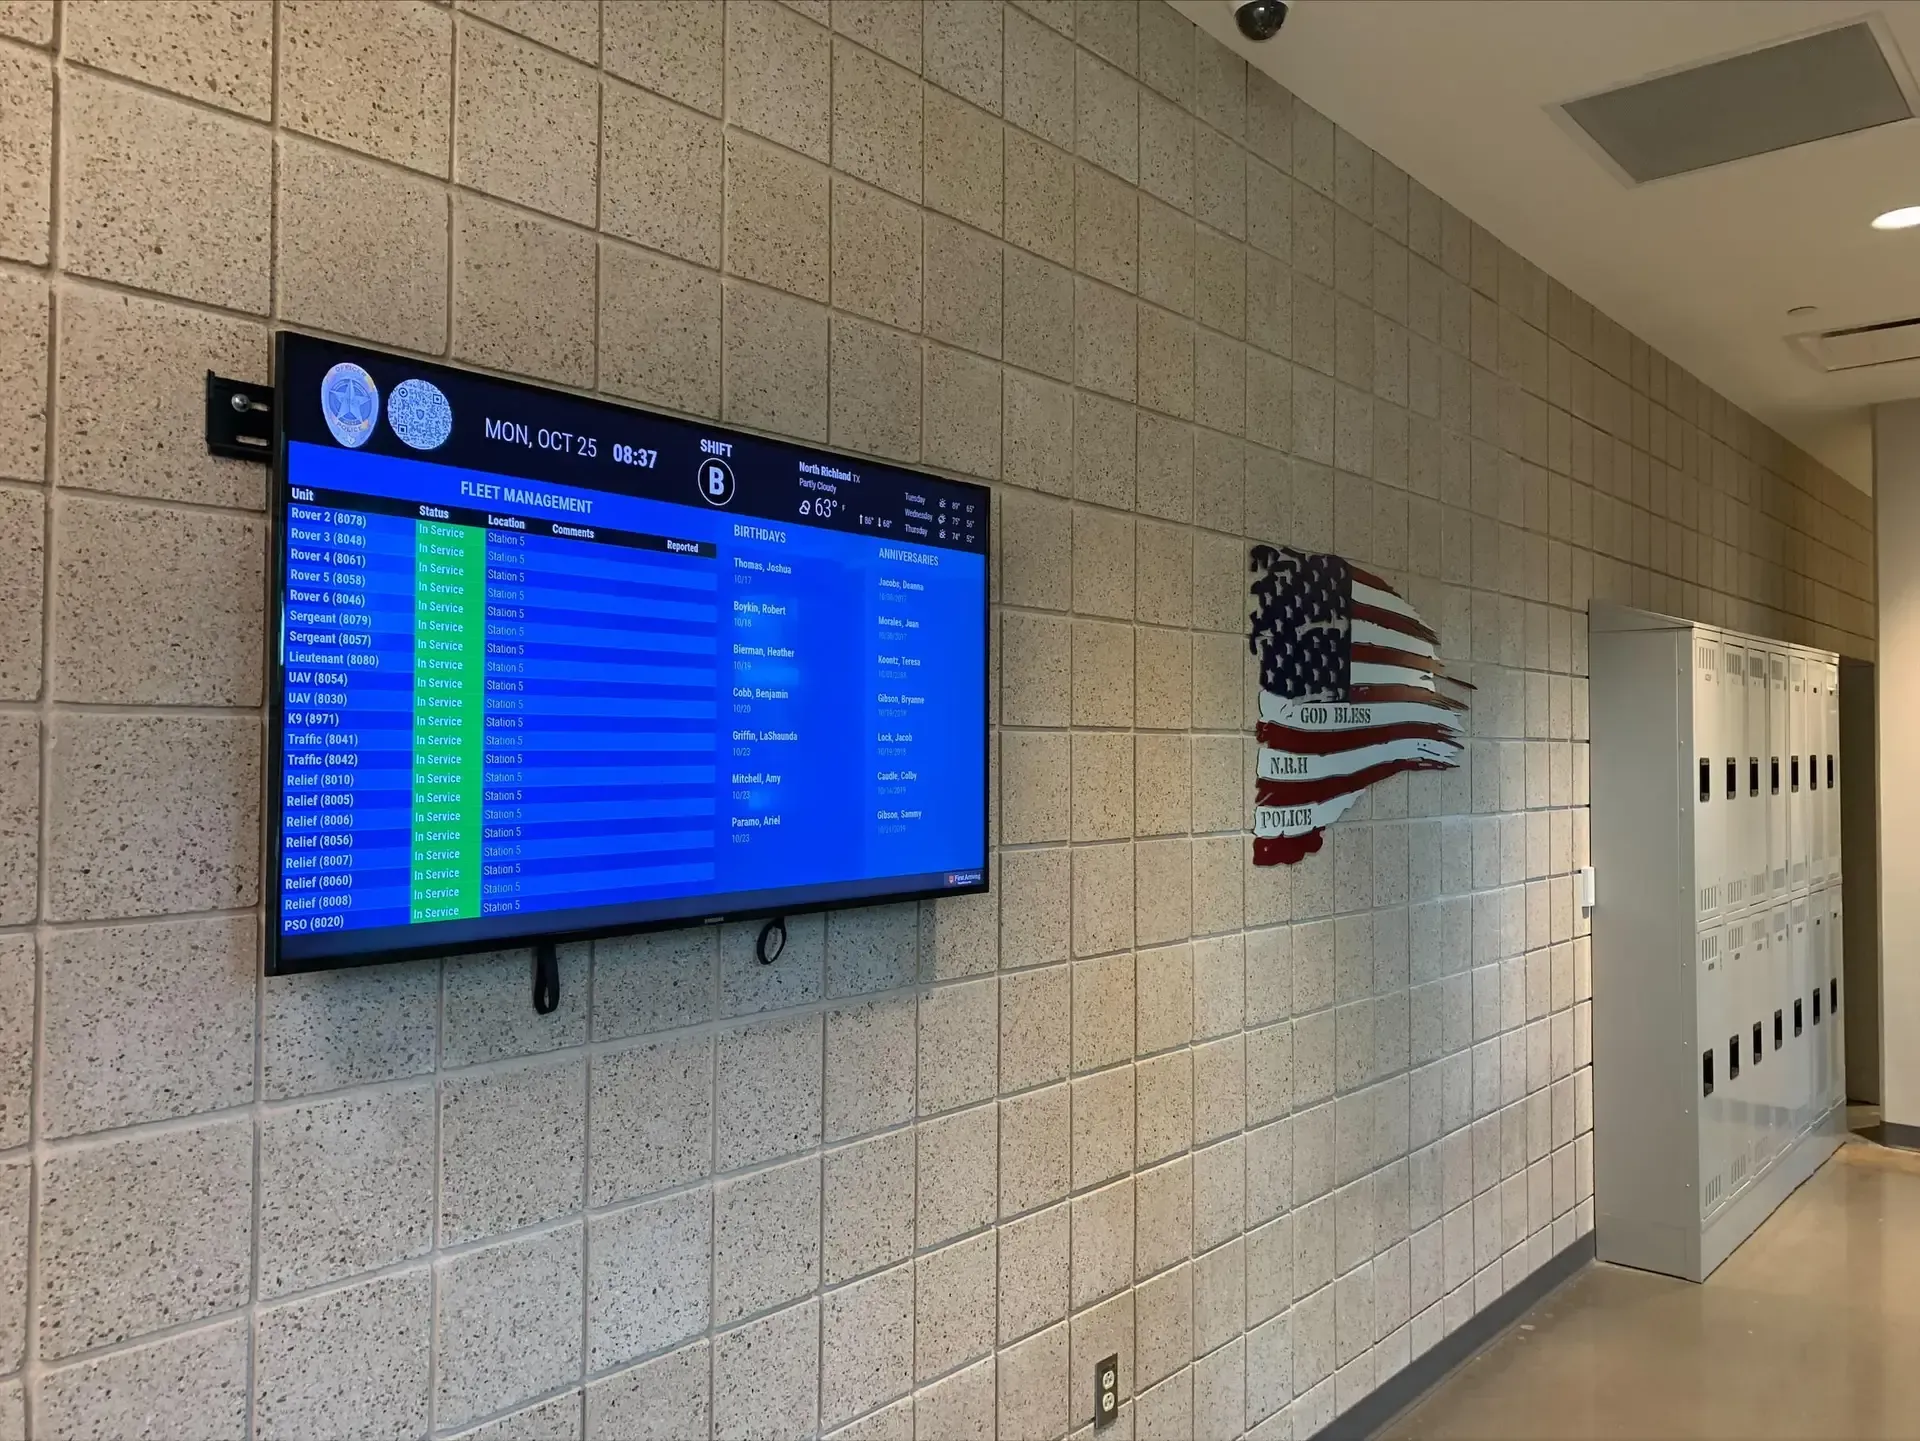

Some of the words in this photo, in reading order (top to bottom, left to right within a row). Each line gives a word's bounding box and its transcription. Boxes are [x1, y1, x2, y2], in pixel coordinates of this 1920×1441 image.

[485, 417, 532, 449] MON,
[538, 429, 571, 453] OCT
[578, 436, 597, 458] 25
[700, 439, 732, 457] SHIFT
[613, 443, 657, 468] 08:37
[799, 461, 820, 476] North
[821, 467, 851, 482] Richland
[853, 474, 860, 483] TX
[709, 466, 724, 495] B
[800, 478, 816, 490] Partly
[817, 482, 836, 494] Cloudy
[292, 488, 314, 501] Unit
[461, 480, 500, 501] FLEET
[504, 488, 592, 514] MANAGEMENT
[905, 492, 925, 505] Tuesday
[292, 508, 322, 521] Rover
[324, 511, 330, 522] 2
[334, 512, 367, 528] (8078)
[420, 505, 449, 519] Status
[905, 508, 933, 522] Wednesday
[488, 515, 525, 529] Location
[420, 524, 428, 533] In
[431, 525, 464, 539] Service
[552, 524, 594, 539] Comments
[734, 524, 786, 543] BIRTHDAYS
[905, 524, 928, 537] Thursday
[291, 529, 321, 541] Rover
[324, 532, 330, 542] 3
[333, 532, 366, 548] (8048)
[488, 533, 517, 544] Station
[520, 536, 525, 545] 5
[667, 540, 698, 553] Reported
[291, 549, 321, 562] Rover
[324, 552, 330, 562] 4
[333, 552, 366, 568] (8061)
[879, 548, 939, 566] ANNIVERSARIES
[734, 558, 765, 572] Thomas,
[767, 563, 792, 574] Joshua
[291, 569, 320, 582] Rover
[323, 572, 330, 582] 5
[333, 573, 366, 588] (8058)
[879, 578, 901, 590] Jacobs,
[903, 581, 924, 591] Deanna
[419, 582, 427, 591] In
[430, 583, 464, 595] Service
[290, 590, 320, 602] Rover
[323, 592, 329, 603] 6
[332, 593, 365, 608] (8046)
[488, 607, 517, 617] Station
[519, 609, 524, 617] 5
[734, 601, 760, 615] Boykin,
[762, 604, 786, 615] Robert
[290, 610, 336, 626] Sergeant
[339, 613, 371, 628] (8079)
[878, 616, 904, 628] Morales,
[905, 619, 919, 628] Juan
[290, 631, 336, 647] Sergeant
[339, 633, 371, 648] (8057)
[418, 639, 427, 649] In
[430, 640, 463, 651] Service
[733, 644, 765, 657] Bierman,
[768, 647, 794, 657] Heather
[289, 652, 343, 664] Lieutenant
[347, 653, 379, 667] (8080)
[902, 656, 920, 666] Teresa
[289, 673, 311, 683] UAV
[314, 673, 348, 687] (8054)
[487, 681, 516, 690] Station
[518, 682, 523, 690] 5
[289, 693, 311, 703] UAV
[314, 693, 347, 707] (8030)
[733, 688, 754, 699] Cobb,
[756, 689, 788, 700] Benjamin
[878, 694, 900, 704] Gibson,
[417, 697, 426, 706] In
[429, 697, 462, 707] Service
[288, 713, 301, 724] K9
[305, 712, 339, 727] (8971)
[1301, 707, 1327, 724] GOD
[1334, 708, 1371, 723] BLESS
[288, 733, 322, 745] Traffic
[325, 733, 358, 747] (8041)
[733, 731, 757, 742] Griffin,
[760, 731, 797, 741] LaShaunda
[878, 733, 893, 743] Lock,
[895, 733, 912, 741] Jacob
[288, 754, 322, 765] Traffic
[325, 753, 358, 767] (8042)
[416, 755, 425, 764] In
[428, 754, 461, 764] Service
[486, 755, 514, 764] Station
[517, 754, 522, 763] 5
[1271, 757, 1308, 774] N.R.H
[287, 775, 317, 785] Relief
[321, 773, 354, 788] (8010)
[732, 773, 763, 784] Mitchell,
[766, 774, 781, 785] Amy
[901, 771, 917, 782] Colby
[287, 795, 317, 806] Relief
[320, 793, 353, 808] (8005)
[286, 815, 317, 827] Relief
[320, 814, 353, 829] (8006)
[416, 813, 424, 822] In
[427, 812, 460, 821] Service
[732, 817, 761, 828] Paramo,
[763, 815, 780, 826] Ariel
[877, 811, 899, 820] Gibson,
[901, 810, 922, 820] Sammy
[1261, 808, 1312, 828] POLICE
[485, 828, 514, 838] Station
[516, 827, 521, 836] 5
[286, 835, 317, 848] Relief
[320, 834, 353, 849] (8056)
[286, 856, 316, 868] Relief
[319, 854, 352, 869] (8007)
[415, 870, 423, 880] In
[426, 869, 459, 879] Service
[285, 876, 316, 889] Relief
[319, 874, 352, 890] (8060)
[285, 896, 315, 910] Relief
[319, 894, 352, 910] (8008)
[483, 903, 512, 913] Station
[515, 901, 520, 909] 5
[285, 919, 307, 931] PSO
[310, 915, 344, 930] (8020)
